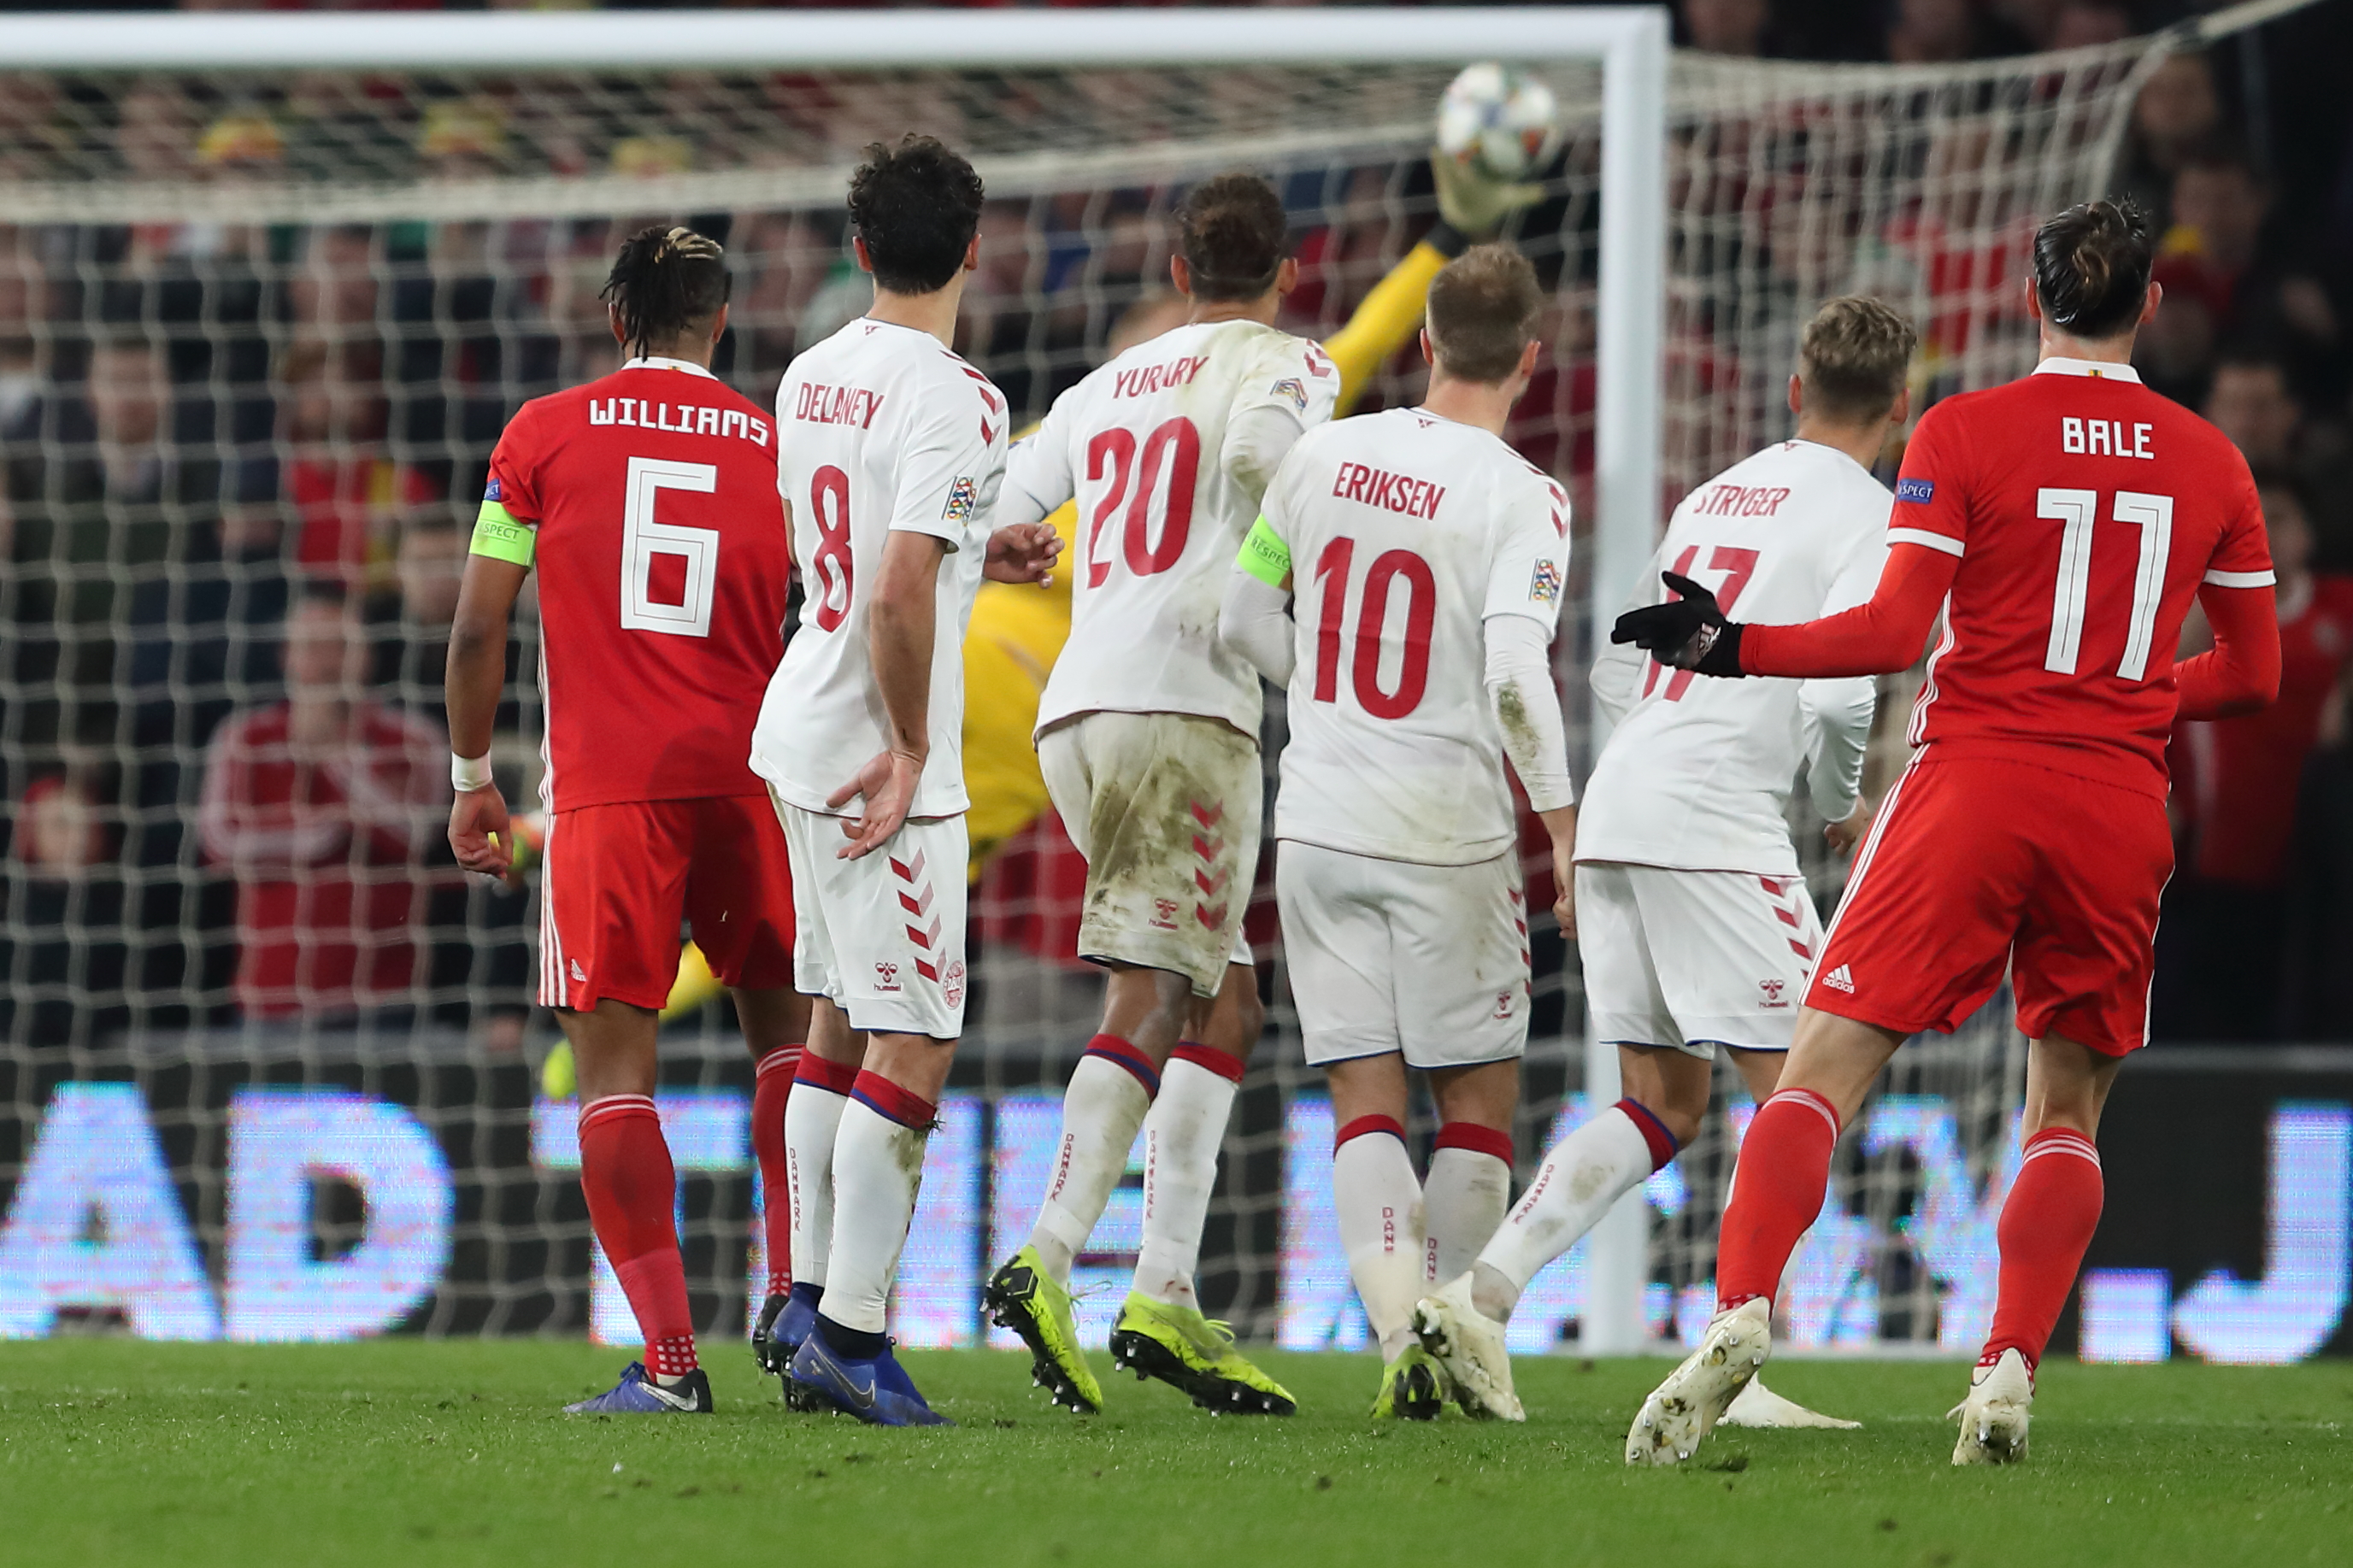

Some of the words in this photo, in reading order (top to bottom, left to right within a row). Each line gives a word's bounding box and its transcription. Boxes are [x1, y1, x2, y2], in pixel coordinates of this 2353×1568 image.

[590, 398, 768, 446] WILLIAMS
[796, 382, 884, 430] DELANEY
[2062, 417, 2154, 459] BALE
[1086, 416, 1199, 590] 20
[1332, 462, 1446, 520] ERIKSEN
[1694, 484, 1791, 517] STRYGER
[621, 456, 720, 637] 6
[812, 465, 853, 632] 8
[1251, 537, 1290, 568] RESPEC
[2038, 488, 2174, 681] 11
[1313, 536, 1437, 719] 10
[1822, 977, 1855, 994] adidas
[788, 1147, 800, 1232] DANMARK
[1049, 1132, 1074, 1202] DANMARK
